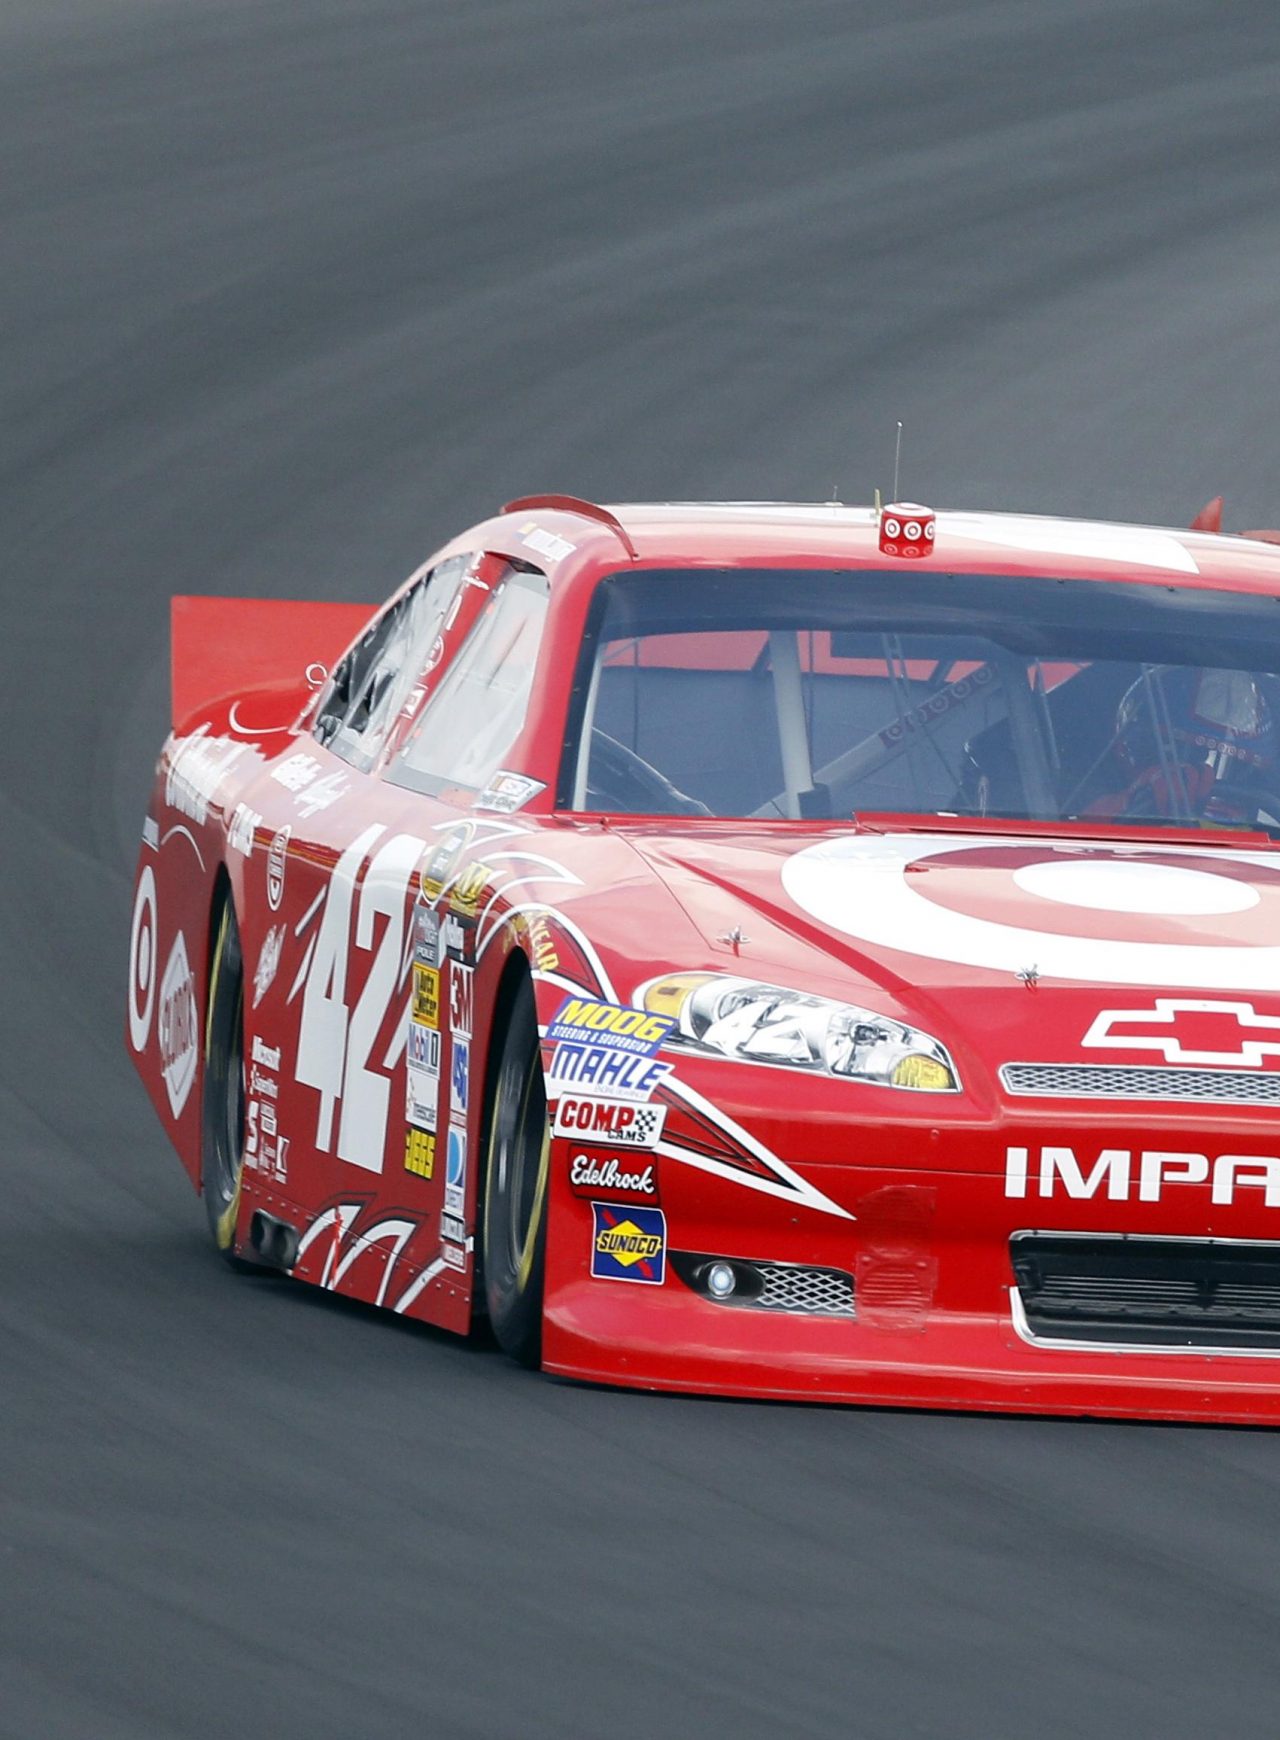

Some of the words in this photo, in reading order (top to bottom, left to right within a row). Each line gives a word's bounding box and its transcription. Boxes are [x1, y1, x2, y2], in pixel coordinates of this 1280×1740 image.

[294, 823, 427, 1174] 42
[451, 966, 473, 1032] 3M
[551, 1025, 591, 1041] STEERING
[597, 1033, 653, 1053] SUSPENSION
[555, 1000, 673, 1042] MOOG
[551, 1044, 669, 1091] MAHLE
[560, 1100, 635, 1131] COMP
[608, 1129, 647, 1142] CAMS
[571, 1154, 654, 1194] Edelbrock
[599, 1234, 658, 1255] SUNOCO
